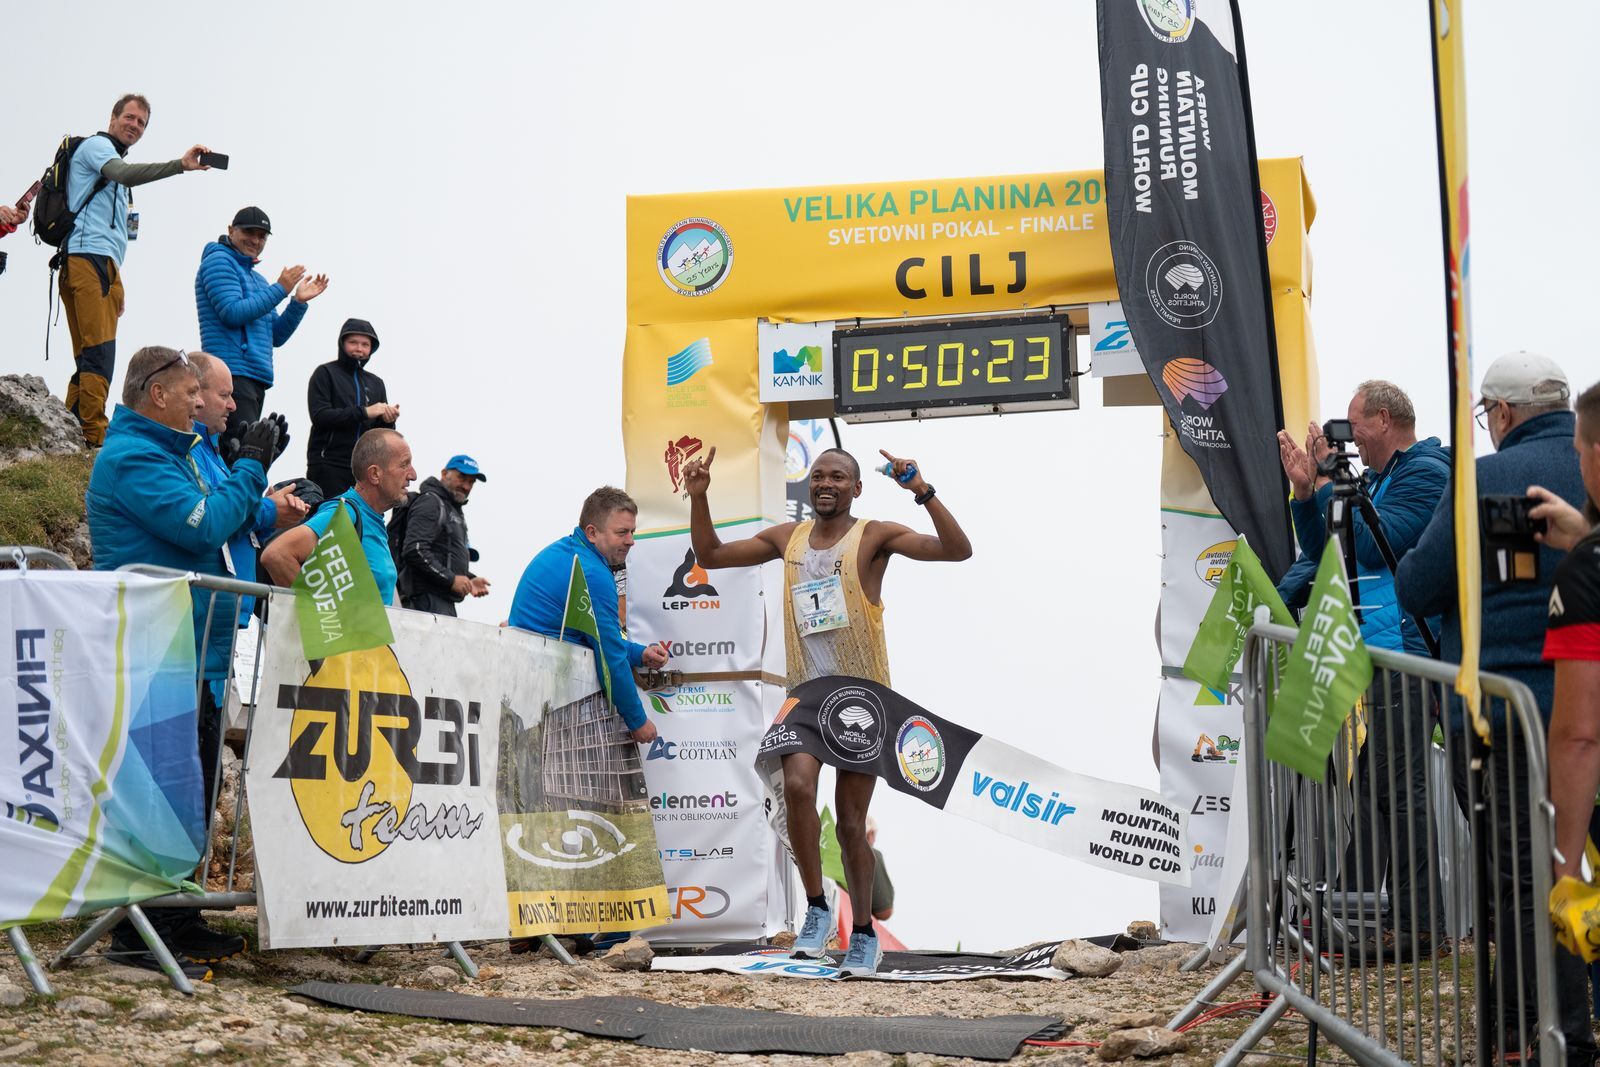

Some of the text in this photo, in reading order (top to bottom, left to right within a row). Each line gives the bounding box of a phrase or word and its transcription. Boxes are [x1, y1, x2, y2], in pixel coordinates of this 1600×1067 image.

[784, 178, 1105, 223] VELIKA PLANINA 20
[664, 219, 688, 240] MOUNTAIN
[828, 222, 926, 246] SVETOVNI
[931, 219, 1000, 240] POKAL
[1020, 213, 1095, 234] FINALE
[686, 262, 719, 284] 25 Years
[895, 251, 1027, 299] CILJ
[677, 286, 715, 297] WORLD CUP
[852, 336, 1050, 393] 0:50:23
[773, 374, 823, 387] KAMNIK
[321, 544, 354, 601] FEEL
[300, 550, 343, 643] LOVENIA
[662, 600, 720, 611] LEPTON
[810, 593, 820, 611] 1
[676, 693, 733, 706] SNOVIK
[678, 686, 705, 694] TERME
[821, 690, 866, 725] MOUNTAIN RUNNING
[680, 740, 737, 748] AVTOMEHANIKA
[838, 734, 871, 745] ATHLETICS
[843, 730, 867, 739] WORLD
[679, 748, 737, 760] COTMAN
[857, 748, 878, 759] PERMIT
[650, 791, 738, 809] element
[972, 771, 1076, 826] valsir
[341, 780, 484, 851] team
[670, 813, 678, 821] IN
[680, 812, 739, 821] OBLIKOVANJE
[1139, 798, 1180, 825] WMRA
[1101, 809, 1180, 841] MOUNTAIN
[1110, 830, 1181, 858] RUNNING
[1089, 842, 1182, 875] WORLD CUP
[306, 895, 463, 919] www.zurbiteam.com
[1192, 897, 1216, 915] KLA
